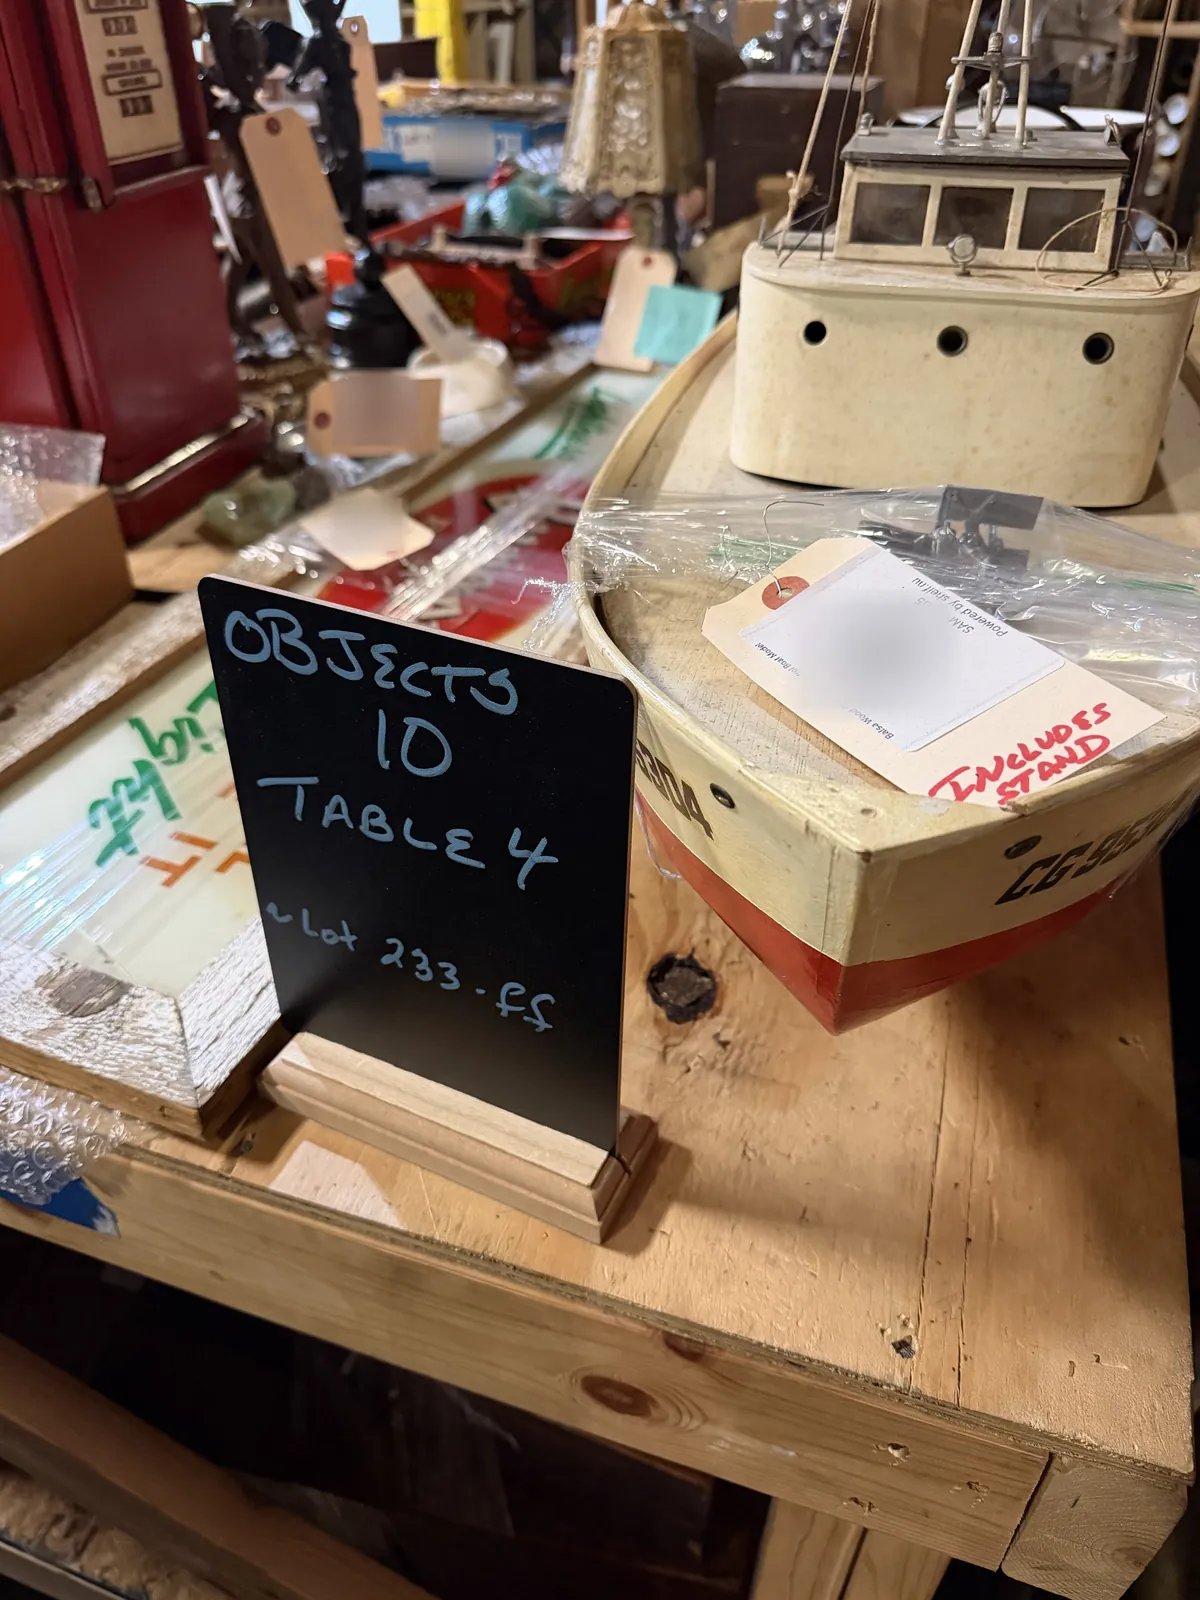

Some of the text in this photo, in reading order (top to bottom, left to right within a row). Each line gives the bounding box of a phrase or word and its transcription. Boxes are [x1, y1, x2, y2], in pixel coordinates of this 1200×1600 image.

[912, 577, 950, 602] shelf.nu
[948, 600, 964, 612] by
[960, 608, 1009, 637] Powered
[224, 608, 519, 716] OBJECTS
[754, 642, 777, 659] Model
[377, 708, 453, 777] 10
[871, 722, 895, 740] Balsa
[928, 702, 1112, 803] INCLUDES
[997, 734, 1111, 805] STAND
[256, 776, 486, 870] TABLE
[508, 827, 559, 890] 4
[380, 941, 461, 991] 233
